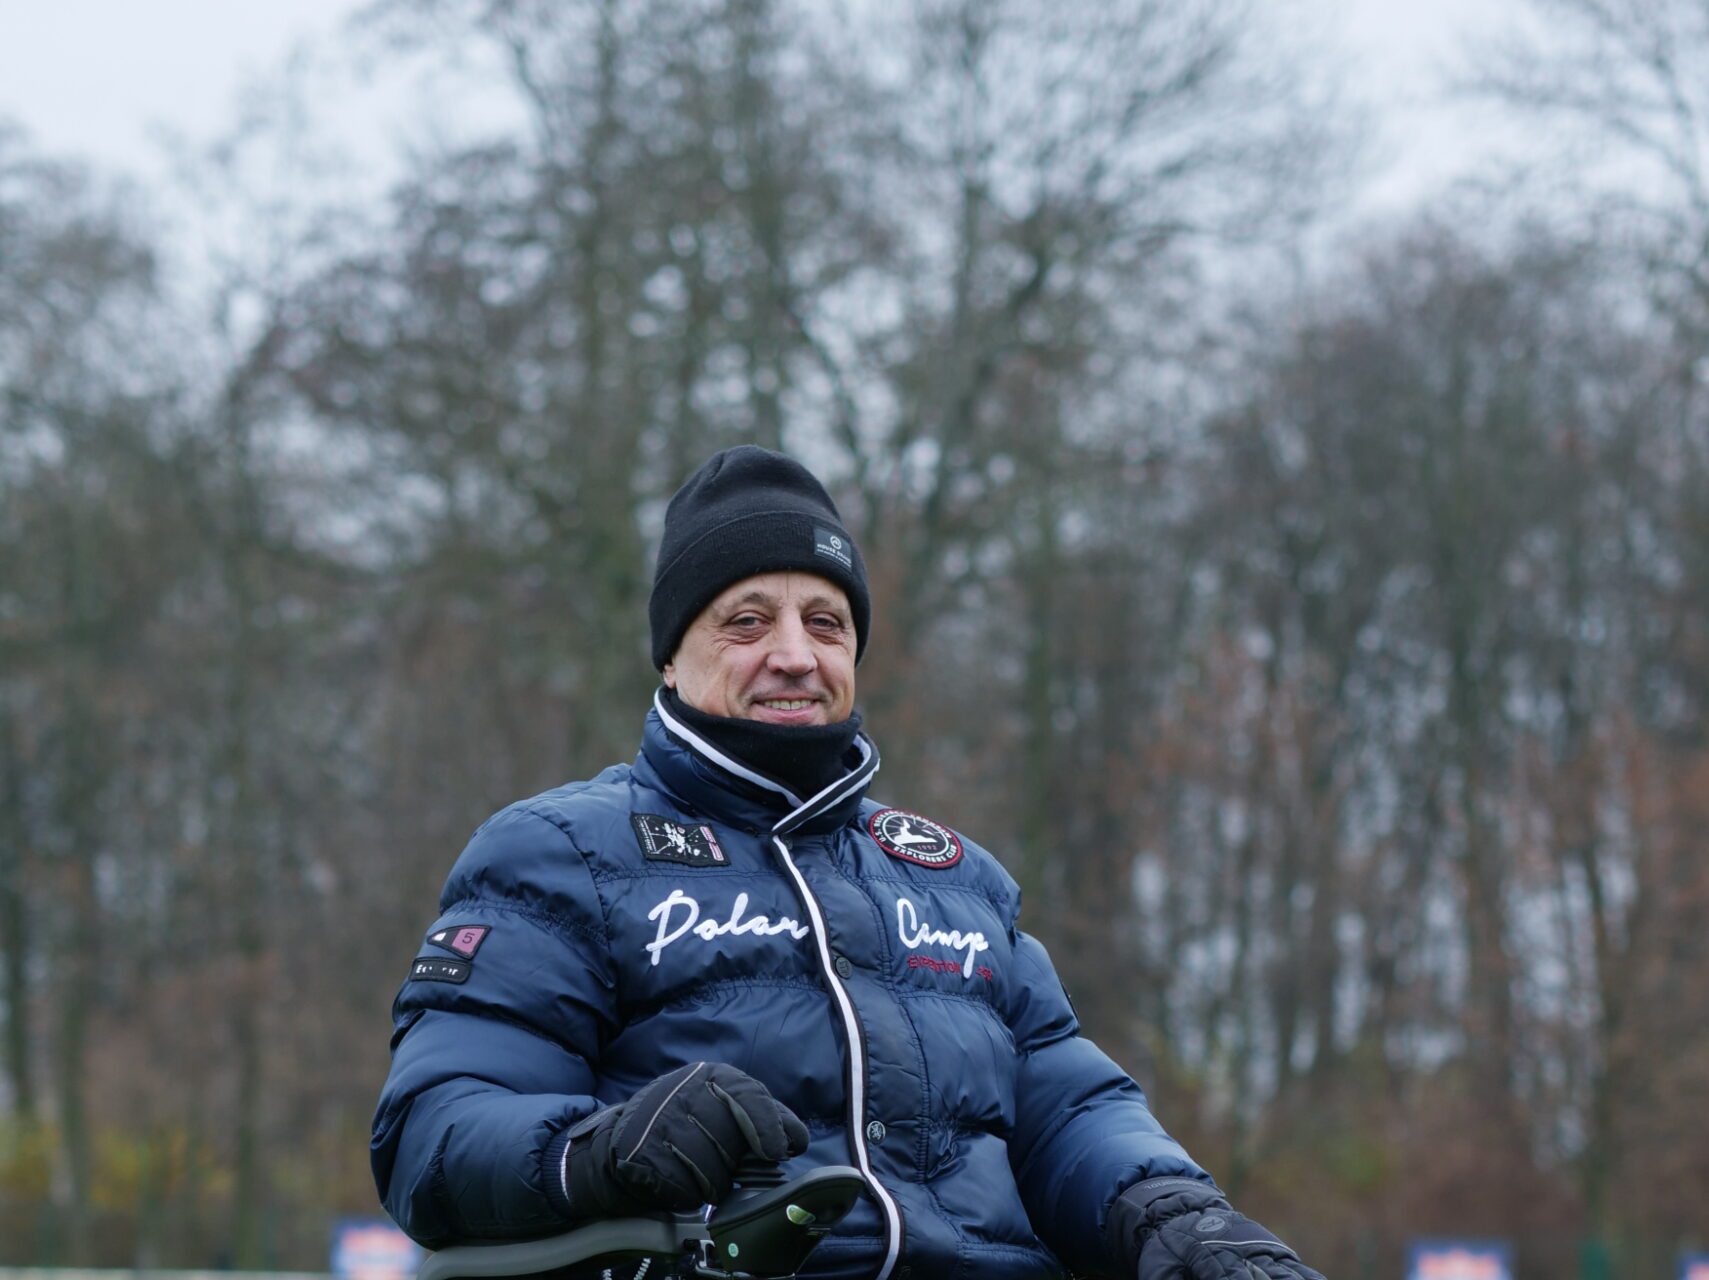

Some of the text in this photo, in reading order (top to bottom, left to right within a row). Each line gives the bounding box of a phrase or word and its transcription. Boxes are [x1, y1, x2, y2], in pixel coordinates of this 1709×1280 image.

[893, 845, 947, 863] EXPLORERS
[462, 931, 476, 945] 5
[645, 889, 989, 979] Polar Camp
